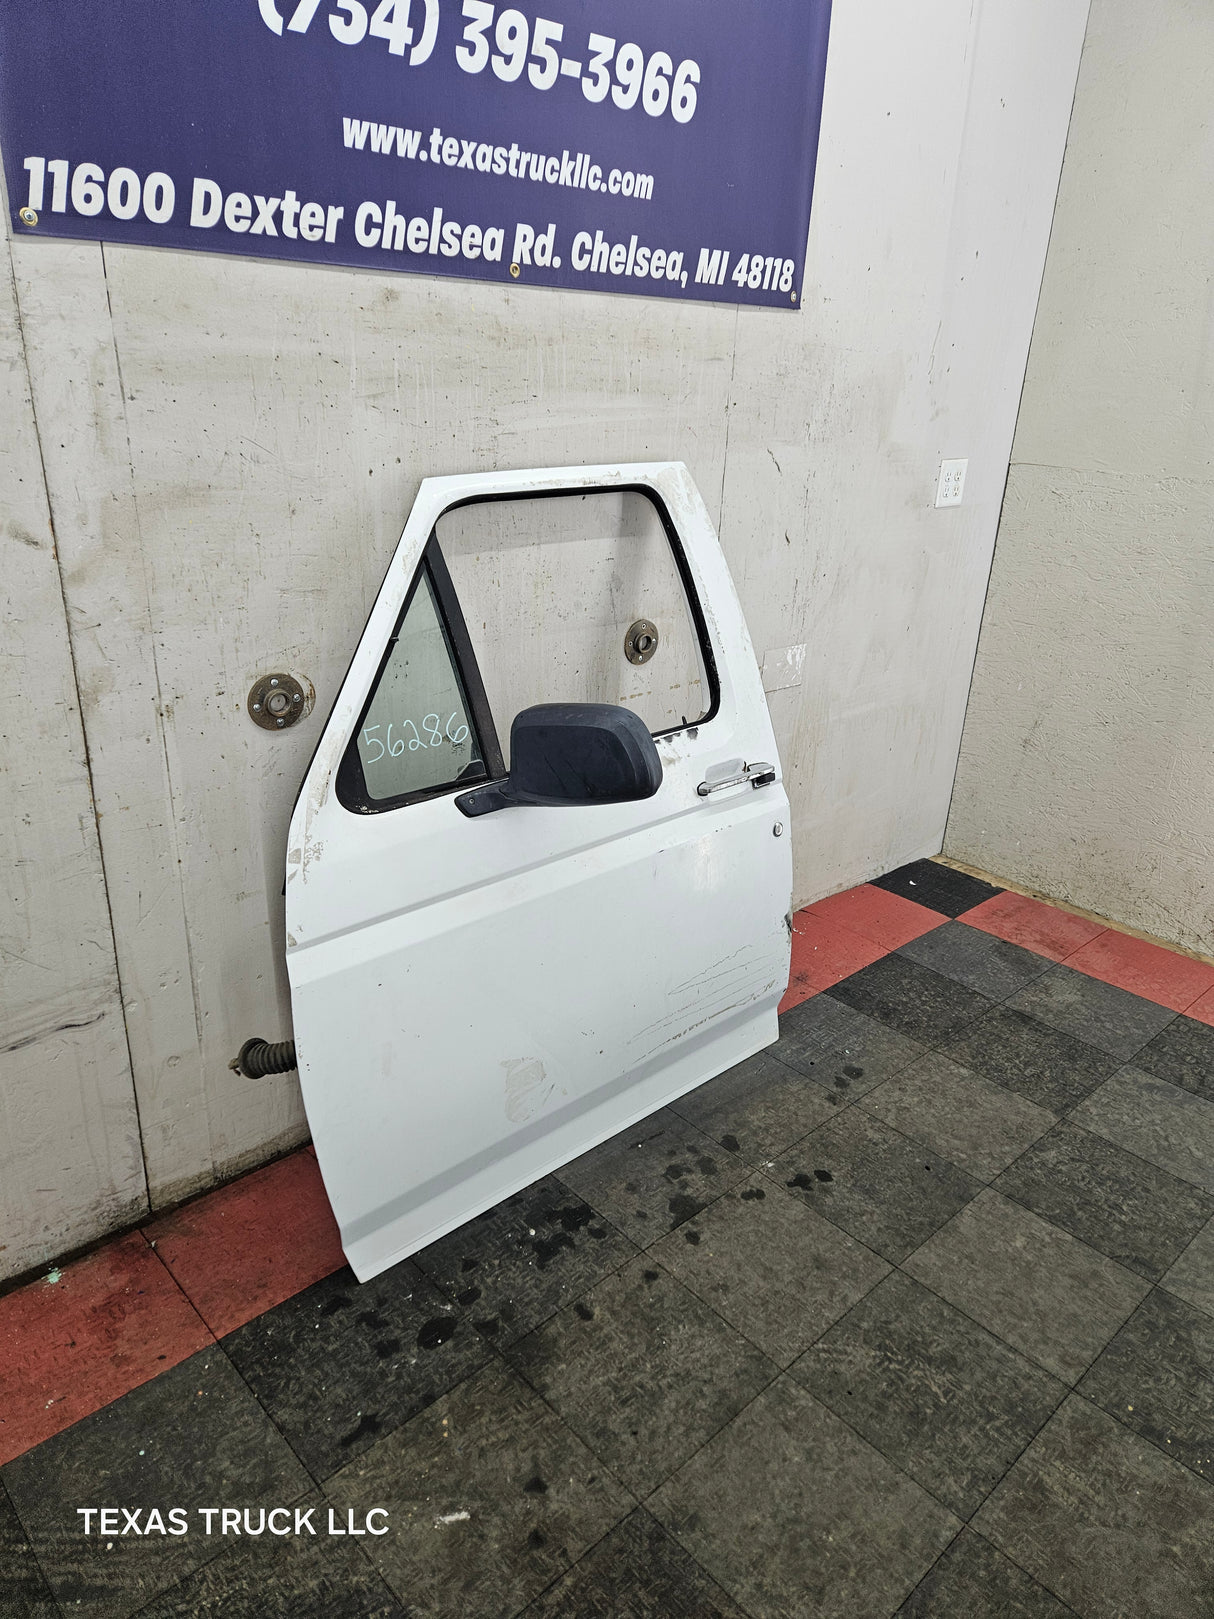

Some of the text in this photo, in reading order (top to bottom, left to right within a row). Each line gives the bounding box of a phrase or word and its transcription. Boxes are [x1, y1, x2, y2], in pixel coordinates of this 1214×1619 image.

[455, 0, 701, 124] 395-3966
[342, 116, 655, 200] www.texastruckllc.com
[22, 156, 795, 293] 11600 Dexter Chelsea Rd. Chelsea, MI 48118
[363, 711, 470, 764] 56286
